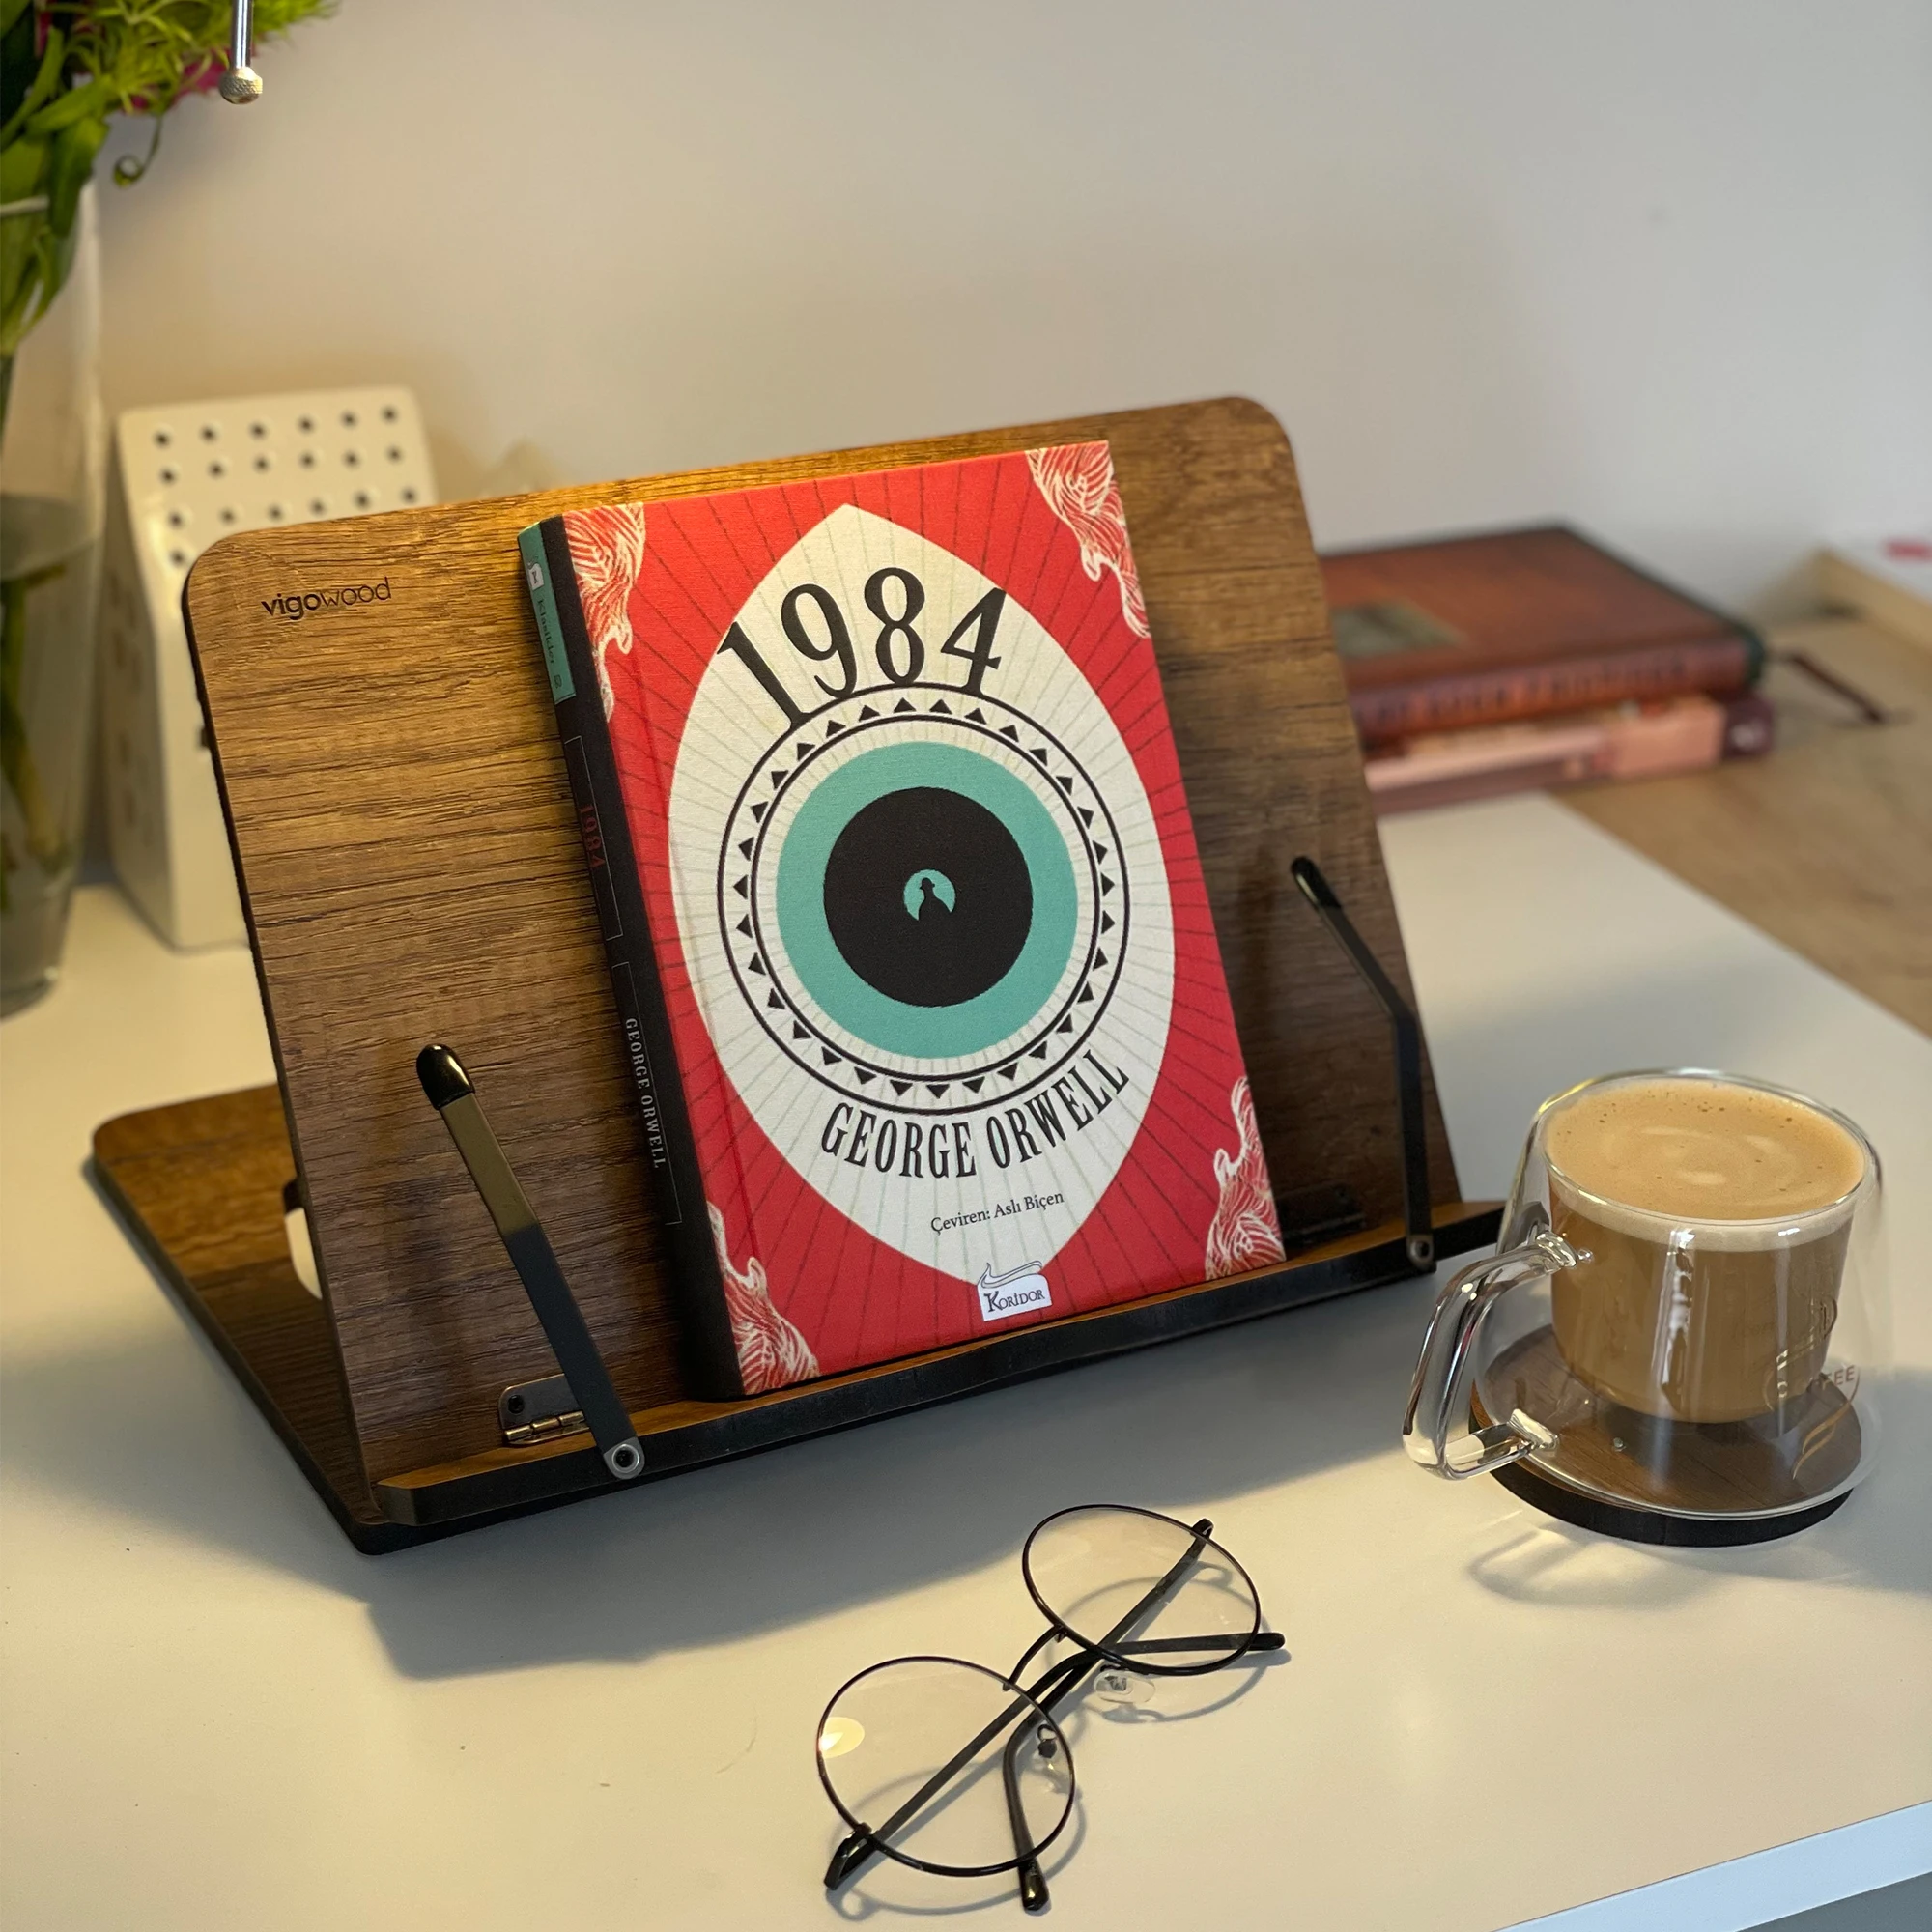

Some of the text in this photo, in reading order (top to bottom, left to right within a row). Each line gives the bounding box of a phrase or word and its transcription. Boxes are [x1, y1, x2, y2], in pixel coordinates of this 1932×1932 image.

[260, 576, 392, 621] vigowood
[717, 567, 1008, 728] 1984
[625, 1017, 667, 1169] GEORGE ORWELL
[820, 1048, 1130, 1179] GEORGE ORWELL
[929, 1191, 1065, 1236] Çeviren: Aslı Biçen
